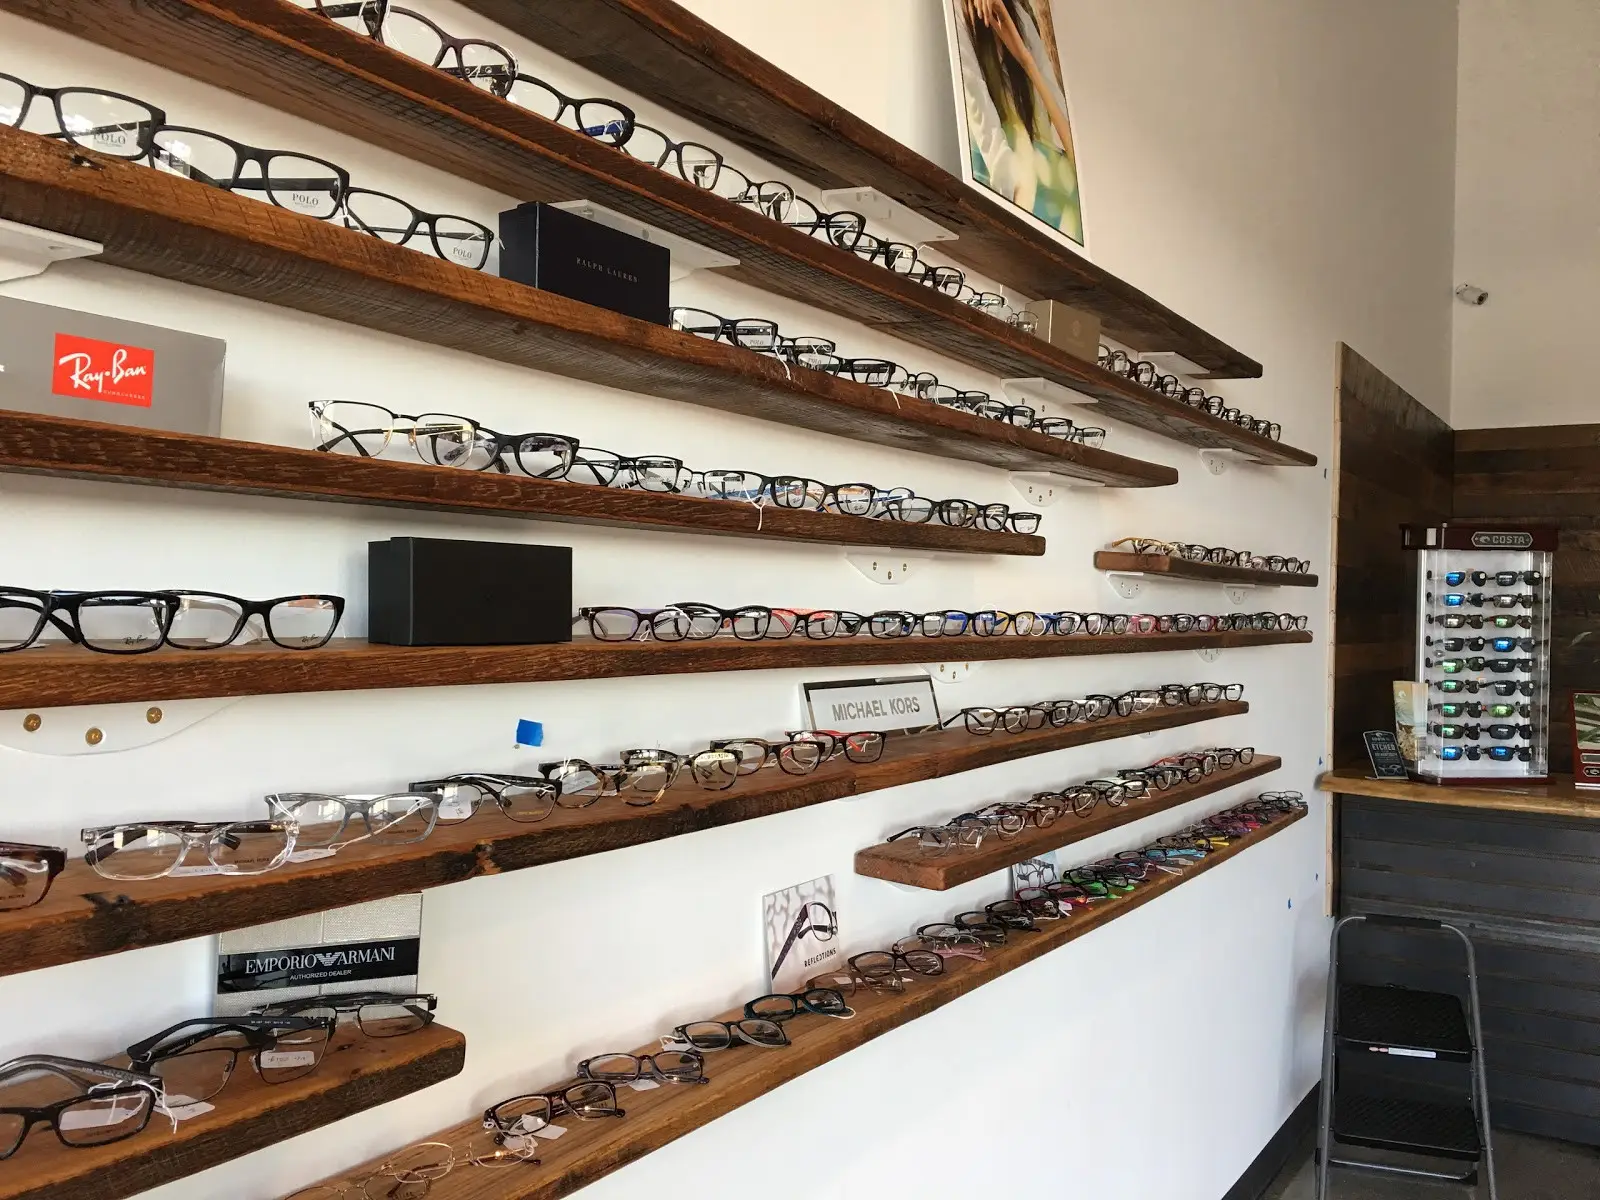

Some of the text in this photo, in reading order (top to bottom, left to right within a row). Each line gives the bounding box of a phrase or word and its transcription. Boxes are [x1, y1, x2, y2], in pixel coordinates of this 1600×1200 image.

[292, 192, 319, 206] POLO
[452, 246, 472, 259] POLO
[576, 256, 639, 283] RALPH LAUREN
[1492, 535, 1525, 544] COSTA
[831, 696, 920, 721] MICHAEL KORS
[245, 946, 396, 975] EMPORIO ARMANI
[804, 947, 837, 967] REFLECTIONS
[289, 969, 352, 981] AUTHORIZED DEALER
